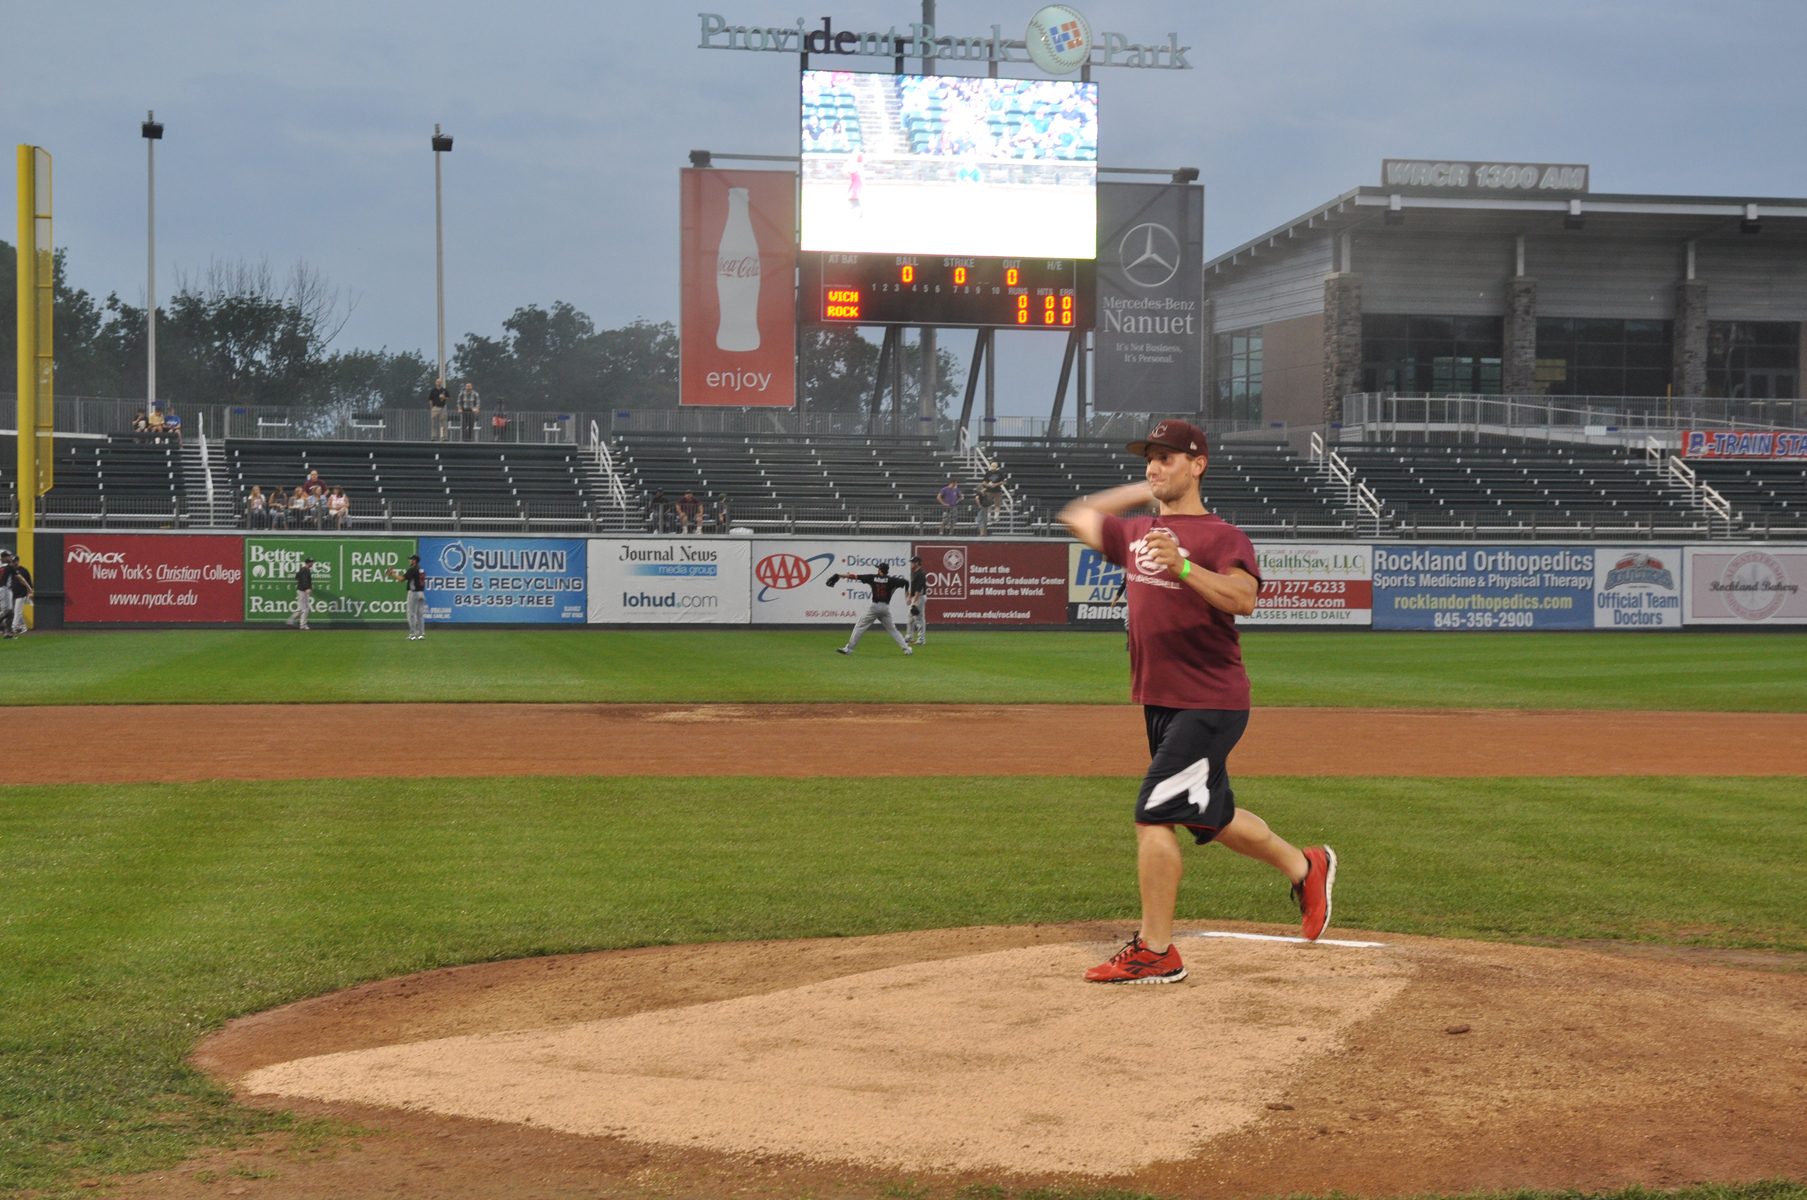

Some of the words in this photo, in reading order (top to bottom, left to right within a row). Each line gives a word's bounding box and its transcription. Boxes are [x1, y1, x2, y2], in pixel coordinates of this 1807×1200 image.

[697, 12, 904, 57] Provident
[909, 22, 1018, 62] Bank
[1101, 31, 1194, 69] Park
[1387, 162, 1470, 186] WRCR
[1475, 164, 1539, 189] 1300
[1540, 166, 1586, 190] AM
[828, 254, 839, 264] AT
[841, 254, 858, 264] BAT
[896, 256, 919, 266] BALL
[943, 257, 975, 268] STRIKE
[1002, 259, 1022, 269] OUT
[1047, 260, 1062, 270] H/E
[902, 265, 913, 283] 0
[955, 266, 966, 284] 0
[1006, 268, 1018, 286] 0
[882, 284, 888, 292] 2
[1008, 287, 1028, 295] RUNS
[1036, 288, 1053, 296] HITS
[828, 291, 859, 303] WICH
[1018, 294, 1028, 308] 0
[1045, 296, 1054, 309] 0
[1062, 296, 1072, 310] 0
[1102, 296, 1195, 310] Mercedes-Benz
[827, 306, 859, 318] ROCK
[1018, 310, 1028, 324] 0
[1045, 310, 1054, 324] 0
[1062, 310, 1072, 324] 0
[1102, 309, 1194, 334] Nanuet
[1116, 342, 1129, 351] It's
[1130, 343, 1144, 352] Not
[1124, 354, 1137, 362] It's
[706, 367, 772, 391] enjoy
[1776, 432, 1807, 456] STA
[67, 551, 126, 564] NYACK
[250, 546, 304, 562] Better
[352, 552, 398, 566] RAND
[619, 545, 674, 562] Journal
[680, 545, 718, 562] News
[848, 555, 906, 567] Discounts
[1075, 549, 1126, 586] RA
[1333, 555, 1363, 568] LLC
[1374, 550, 1467, 571] Rockland
[1474, 551, 1594, 574] Orthopedics
[92, 564, 117, 580] New
[121, 564, 152, 580] York's
[156, 564, 200, 580] Christian
[203, 564, 241, 584] College
[658, 565, 687, 574] media
[689, 566, 716, 576] group
[761, 554, 805, 588] AAA
[970, 565, 988, 574] Start
[998, 566, 1010, 574] the
[426, 576, 467, 590] TREE
[472, 576, 485, 590] &
[489, 576, 584, 592] RECYCLING
[926, 572, 962, 587] ONA
[970, 576, 1004, 584] Rockland
[1006, 576, 1039, 584] Graduate
[1374, 573, 1416, 589] Sports
[1420, 574, 1476, 587] Medicine
[1477, 576, 1486, 587] &
[1488, 574, 1540, 590] Physical
[1543, 574, 1594, 590] Therapy
[846, 588, 872, 600] Trav
[1261, 582, 1282, 594] 77)
[1284, 582, 1346, 593] 277-6233
[1709, 581, 1758, 592] Rockland
[1760, 581, 1798, 594] Bakery
[110, 589, 198, 608] www.nyack.edu
[454, 594, 554, 607] 845-359-TREE
[623, 592, 718, 608] lohud.com
[1394, 594, 1573, 612] rocklandorthopedics.com
[1597, 592, 1644, 608] Official
[1646, 592, 1679, 608] Team
[942, 611, 1030, 620] www.iona.edu/rockland
[1077, 604, 1128, 620] Ramse
[1244, 610, 1288, 620] ASSES
[1291, 610, 1318, 620] HELD
[1321, 610, 1351, 620] DAILY
[1614, 610, 1663, 625] Doctors
[1434, 612, 1534, 627] 845-356-2900
